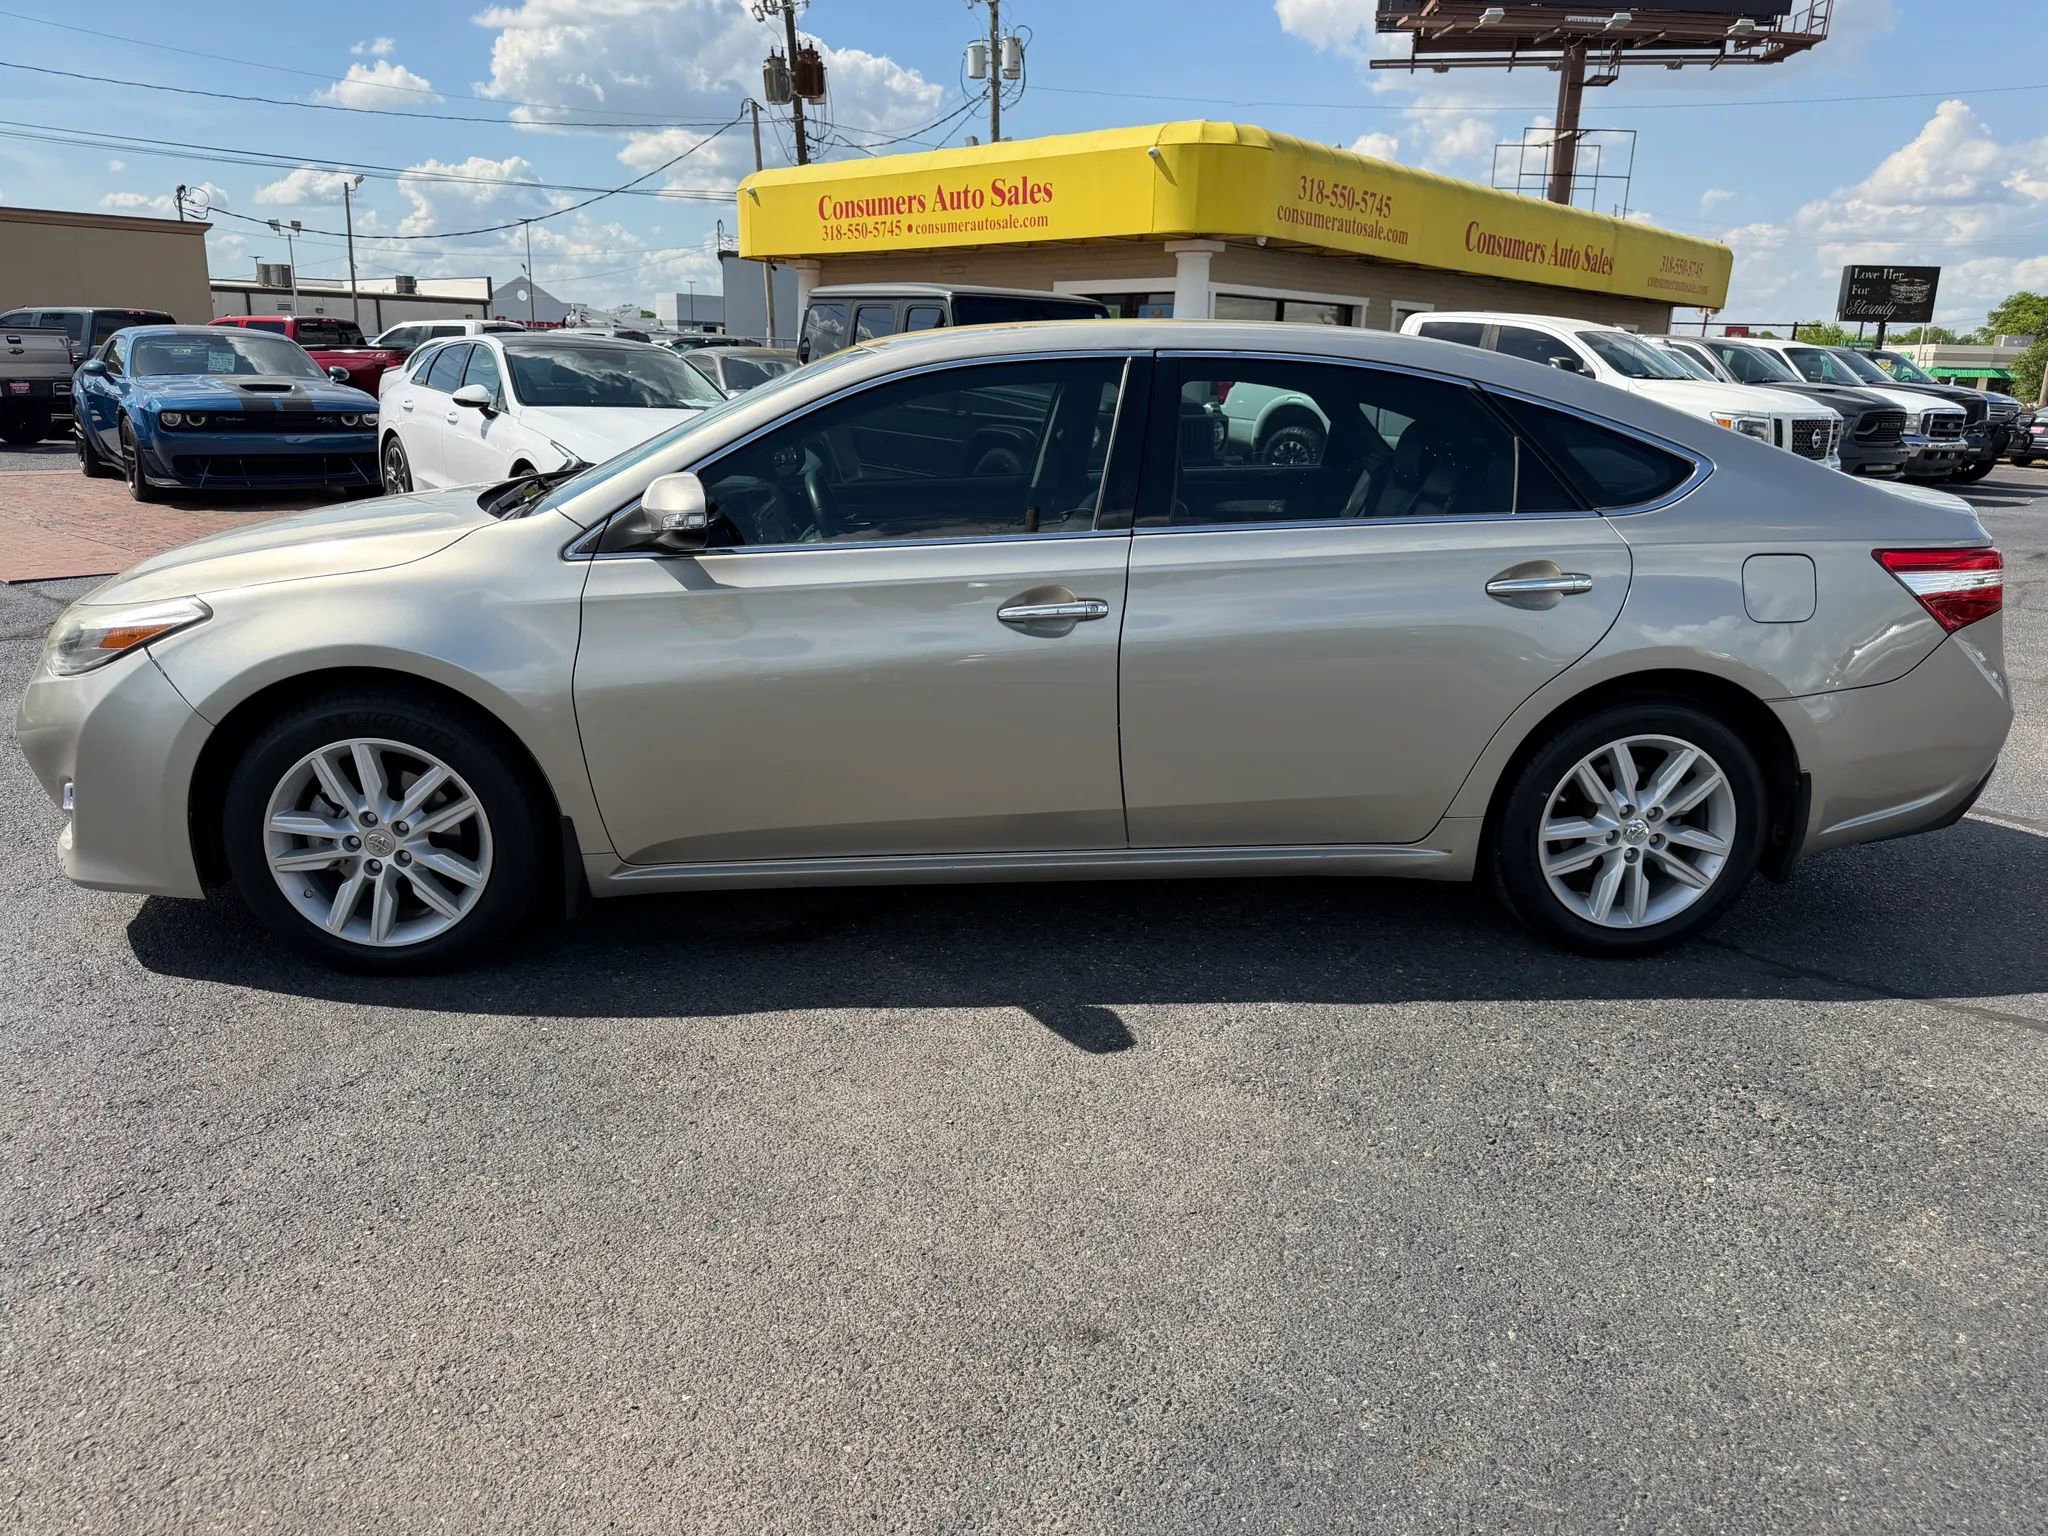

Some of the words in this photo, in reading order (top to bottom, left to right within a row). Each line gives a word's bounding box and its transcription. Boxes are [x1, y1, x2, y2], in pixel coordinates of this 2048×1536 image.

[818, 193, 926, 221] Consumers
[931, 184, 984, 213] Auto
[990, 176, 1053, 207] Sales
[1298, 175, 1393, 219] 318-550-5745
[822, 220, 902, 241] 318-550-5745
[915, 214, 1049, 235] consumerautosale.com
[1277, 204, 1409, 245] consumerautosale.com
[1465, 220, 1547, 265] Consumers
[1548, 237, 1580, 270] Auto
[1582, 244, 1615, 276] Sales
[1851, 284, 1870, 295] For
[1854, 268, 1880, 279] Love
[1883, 268, 1904, 280] Her
[1846, 299, 1897, 321] Eternity
